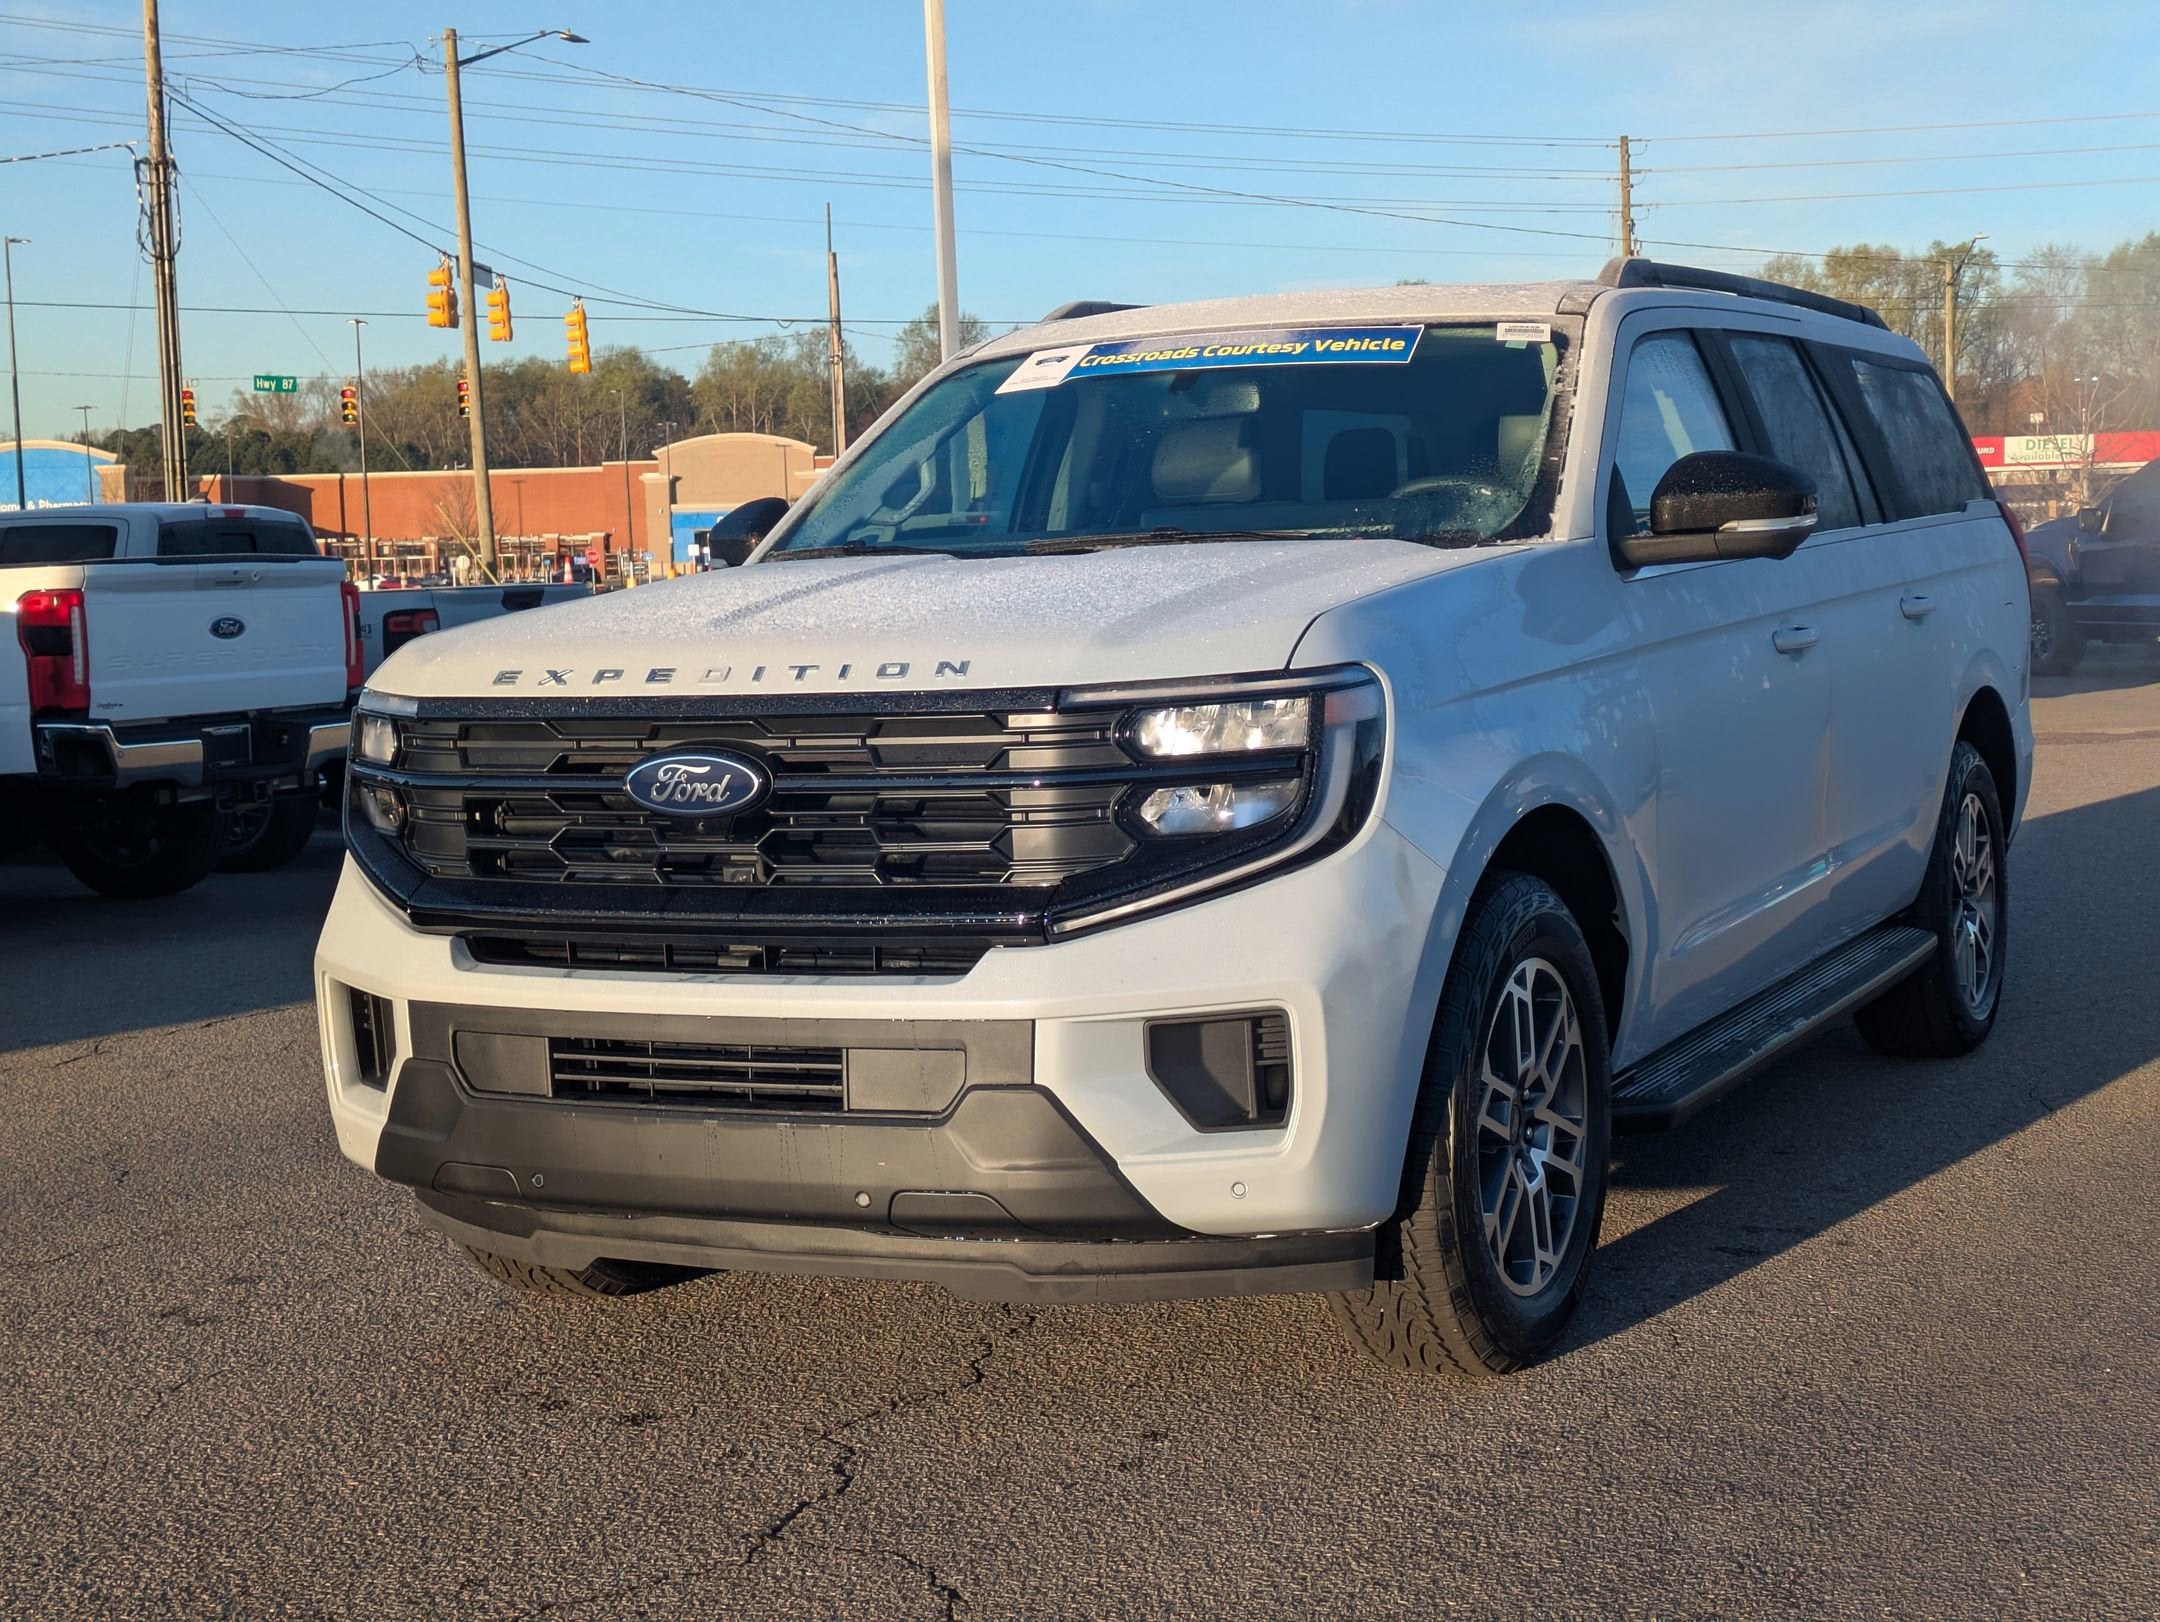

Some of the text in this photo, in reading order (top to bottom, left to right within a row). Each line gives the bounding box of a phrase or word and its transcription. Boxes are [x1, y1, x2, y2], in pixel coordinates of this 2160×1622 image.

[1079, 337, 1406, 367] Crossroads Courtesy Vehicle
[256, 378, 294, 391] Hwy 87
[1975, 446, 1995, 454] UND
[2025, 438, 2076, 451] DIESEL
[218, 620, 240, 634] Ford
[107, 648, 240, 671] SUPER
[492, 660, 972, 687] EXPEDITION
[650, 763, 732, 804] Ford
